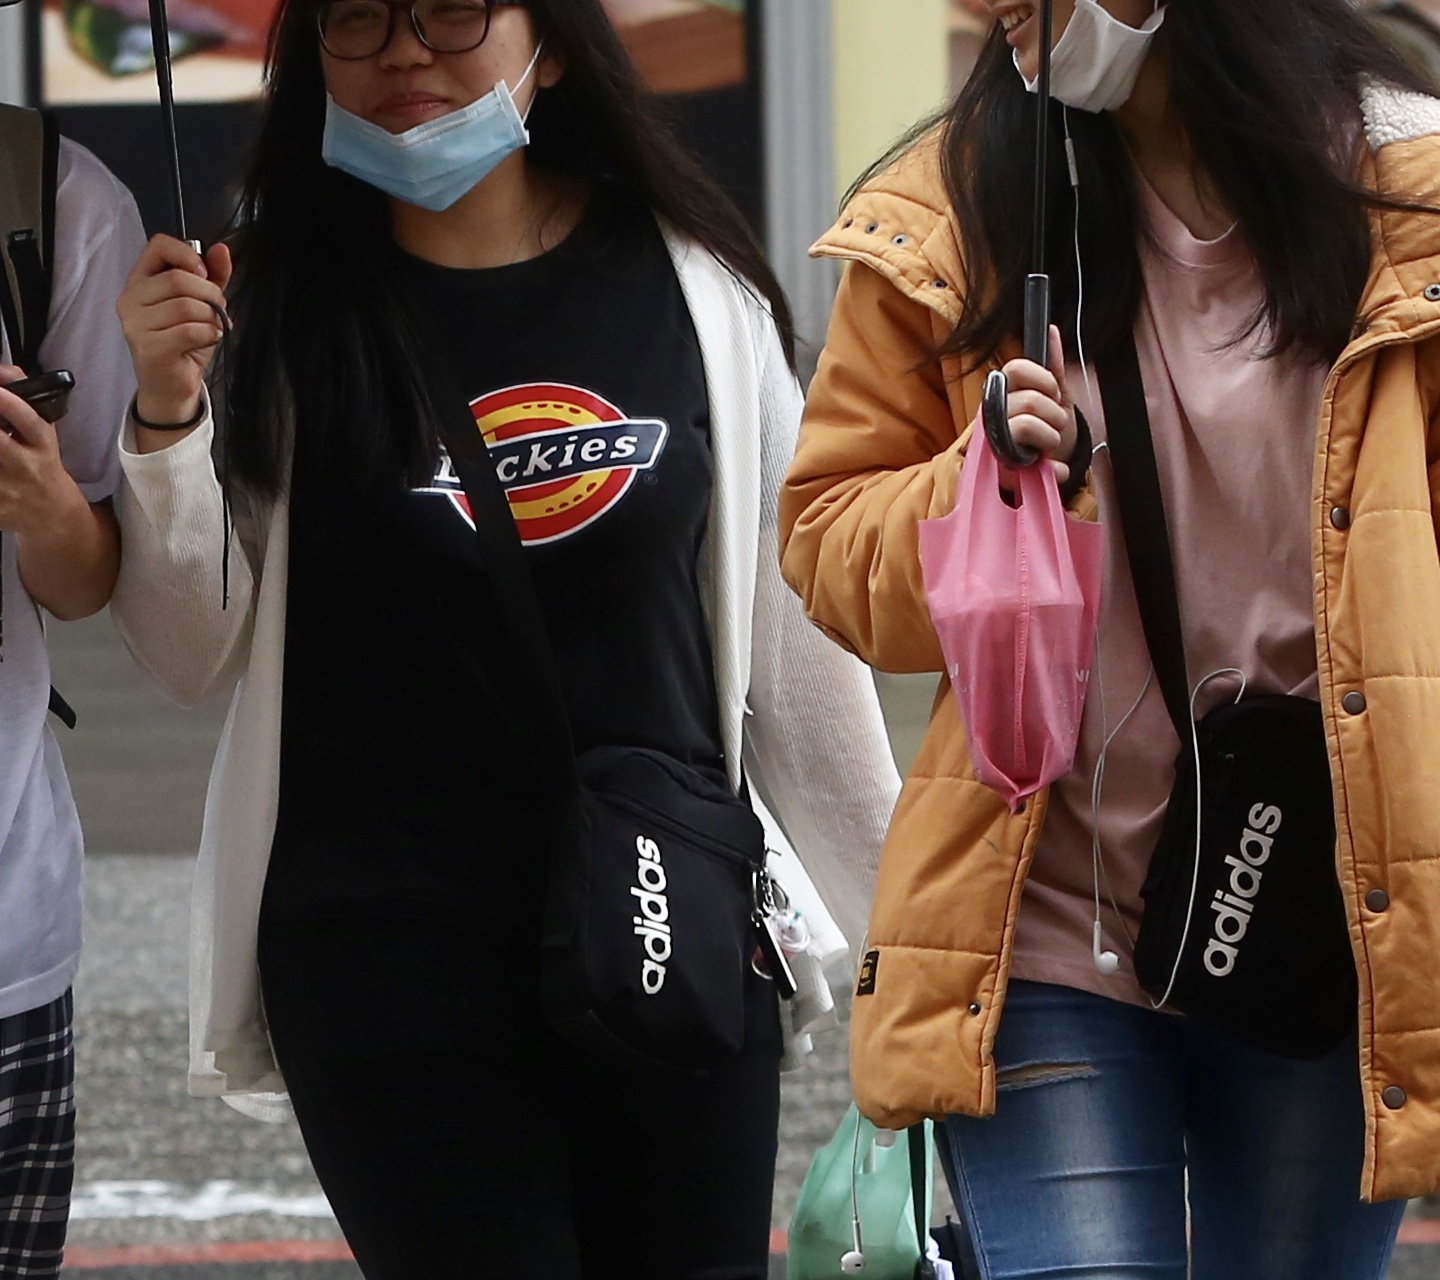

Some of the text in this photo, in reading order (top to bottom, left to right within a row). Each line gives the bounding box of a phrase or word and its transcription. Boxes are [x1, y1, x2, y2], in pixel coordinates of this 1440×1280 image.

[433, 433, 639, 484] ckies
[631, 835, 671, 994] adidas
[1203, 802, 1282, 977] adidas
